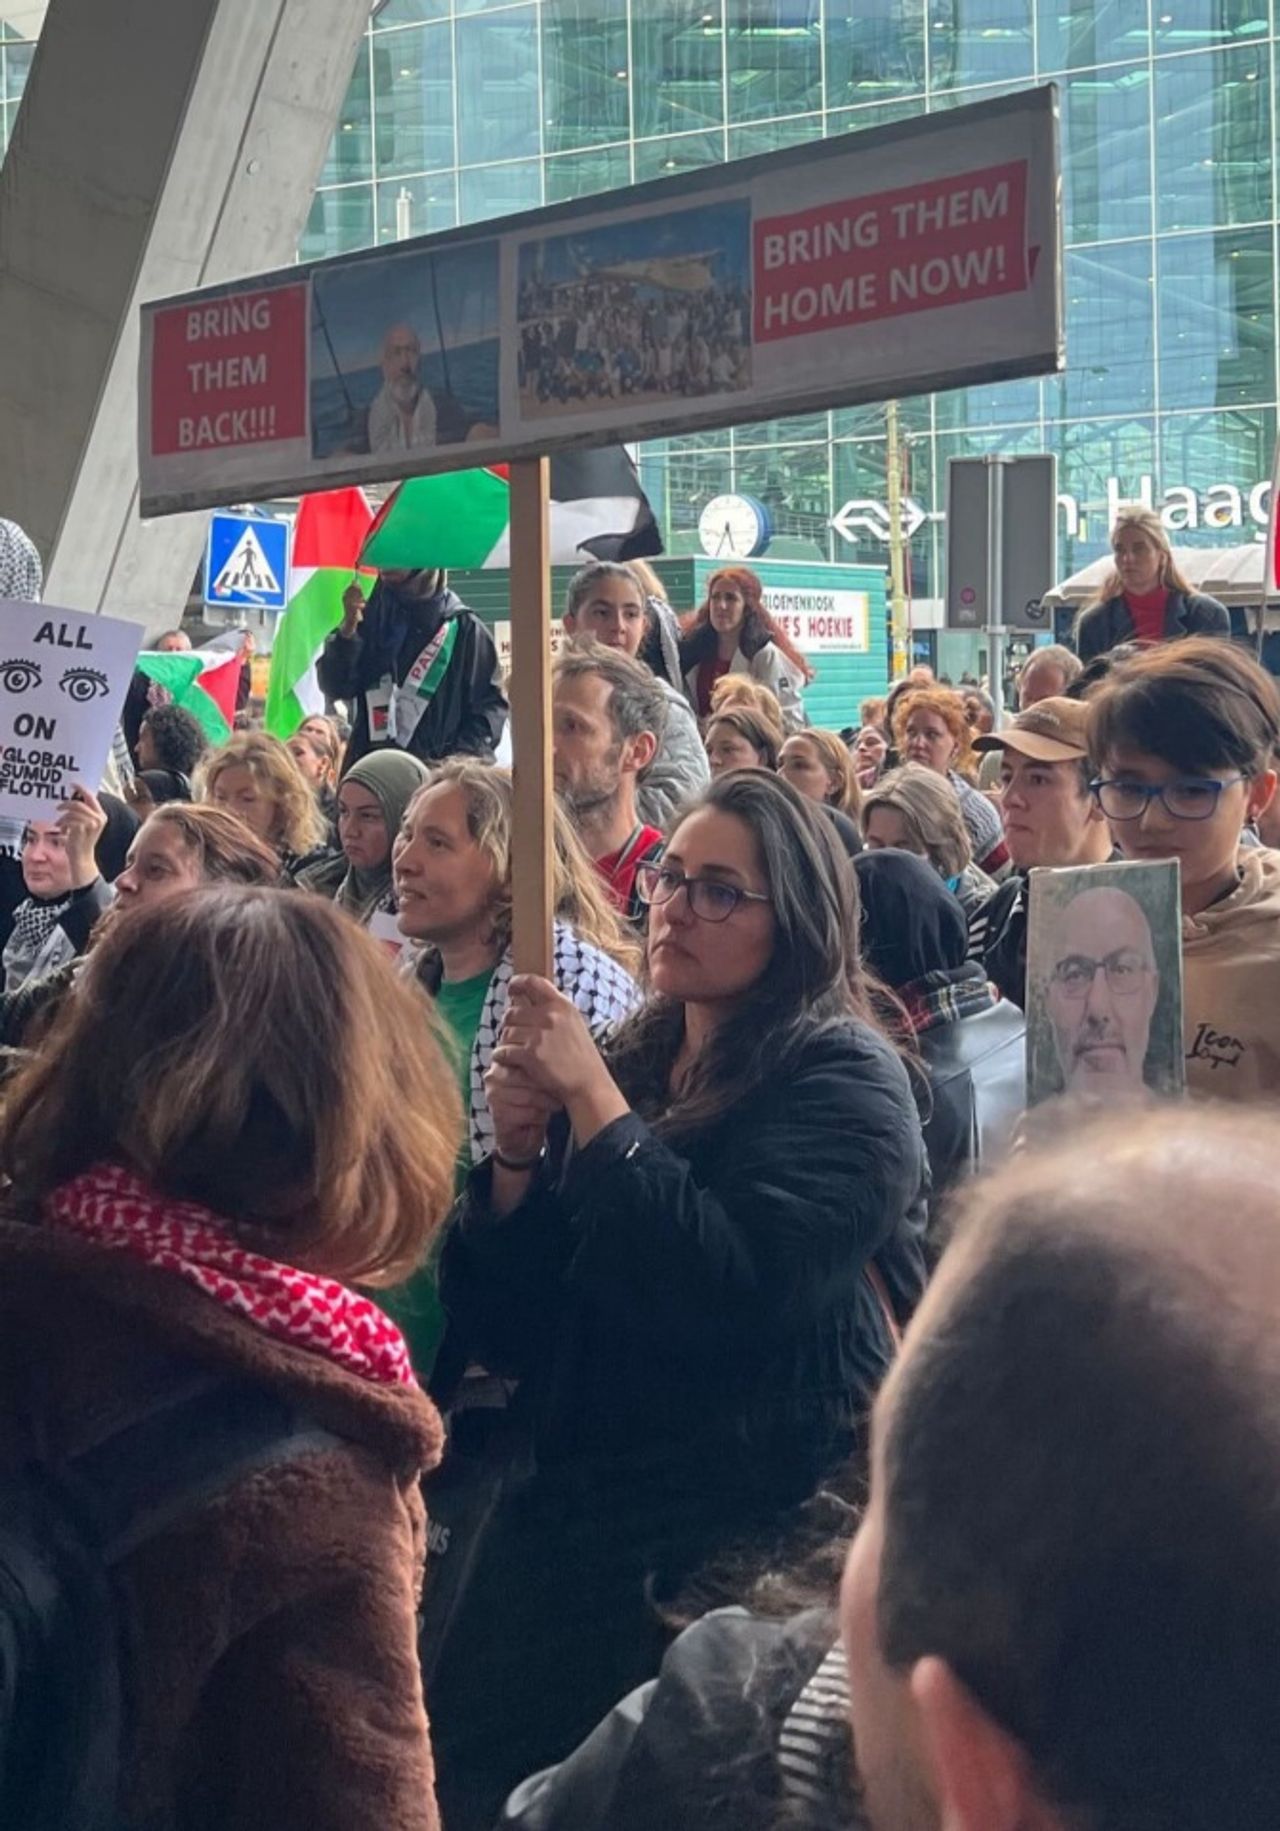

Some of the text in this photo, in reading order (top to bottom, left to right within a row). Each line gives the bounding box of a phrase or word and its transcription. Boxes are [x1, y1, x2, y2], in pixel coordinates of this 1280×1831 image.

[762, 181, 1009, 270] BRING THEM
[763, 245, 1006, 330] HOME NOW!
[186, 298, 271, 342] BRING
[186, 354, 267, 393] THEM
[179, 405, 277, 447] BACK!!!
[33, 621, 93, 650] ALL
[808, 616, 853, 638] HOEKIE
[13, 713, 57, 741] ON
[0, 762, 63, 784] SUMUD
